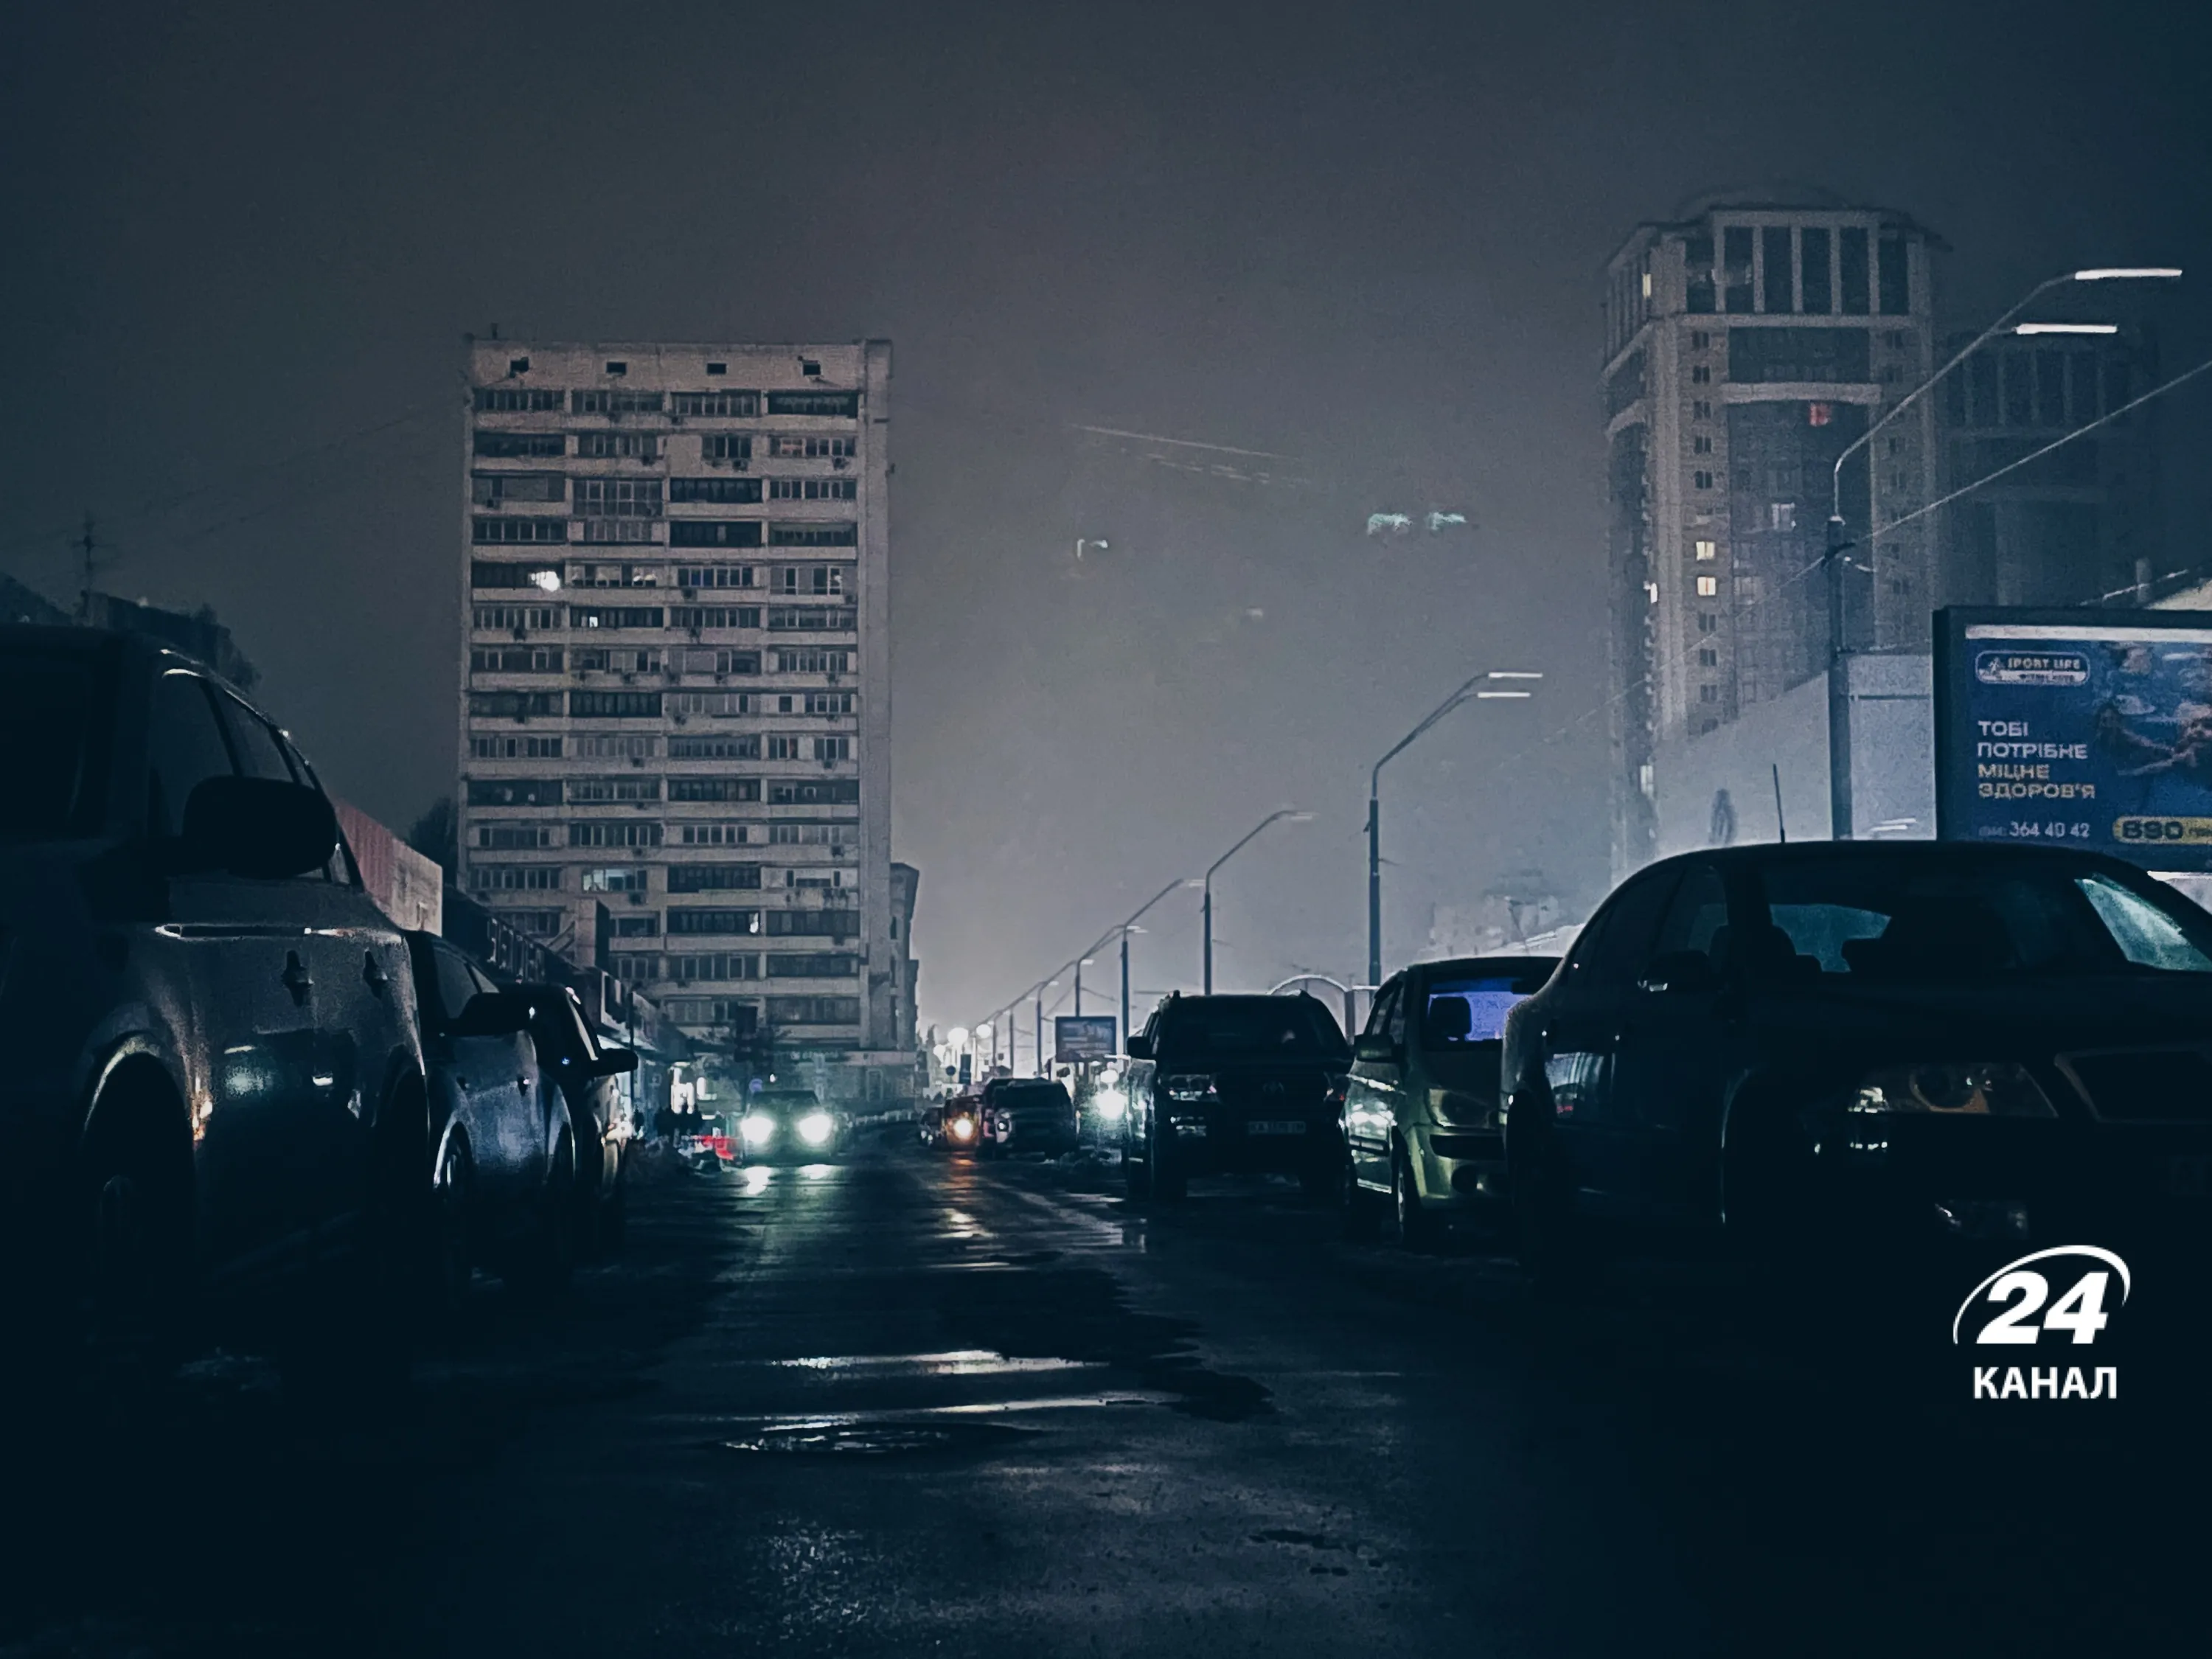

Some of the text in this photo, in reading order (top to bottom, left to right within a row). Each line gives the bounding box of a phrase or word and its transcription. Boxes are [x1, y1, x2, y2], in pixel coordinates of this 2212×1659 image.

[2007, 657, 2049, 669] SPORT
[1978, 720, 2029, 737] ТОБІ
[1977, 742, 2089, 759] ПОТРІБНЕ
[1978, 763, 2051, 781] МІЦНЕ
[1978, 782, 2096, 800] ЗДОРОВ'Я
[2009, 821, 2041, 838] 364
[2045, 821, 2065, 838] 40
[2070, 822, 2090, 838] 42
